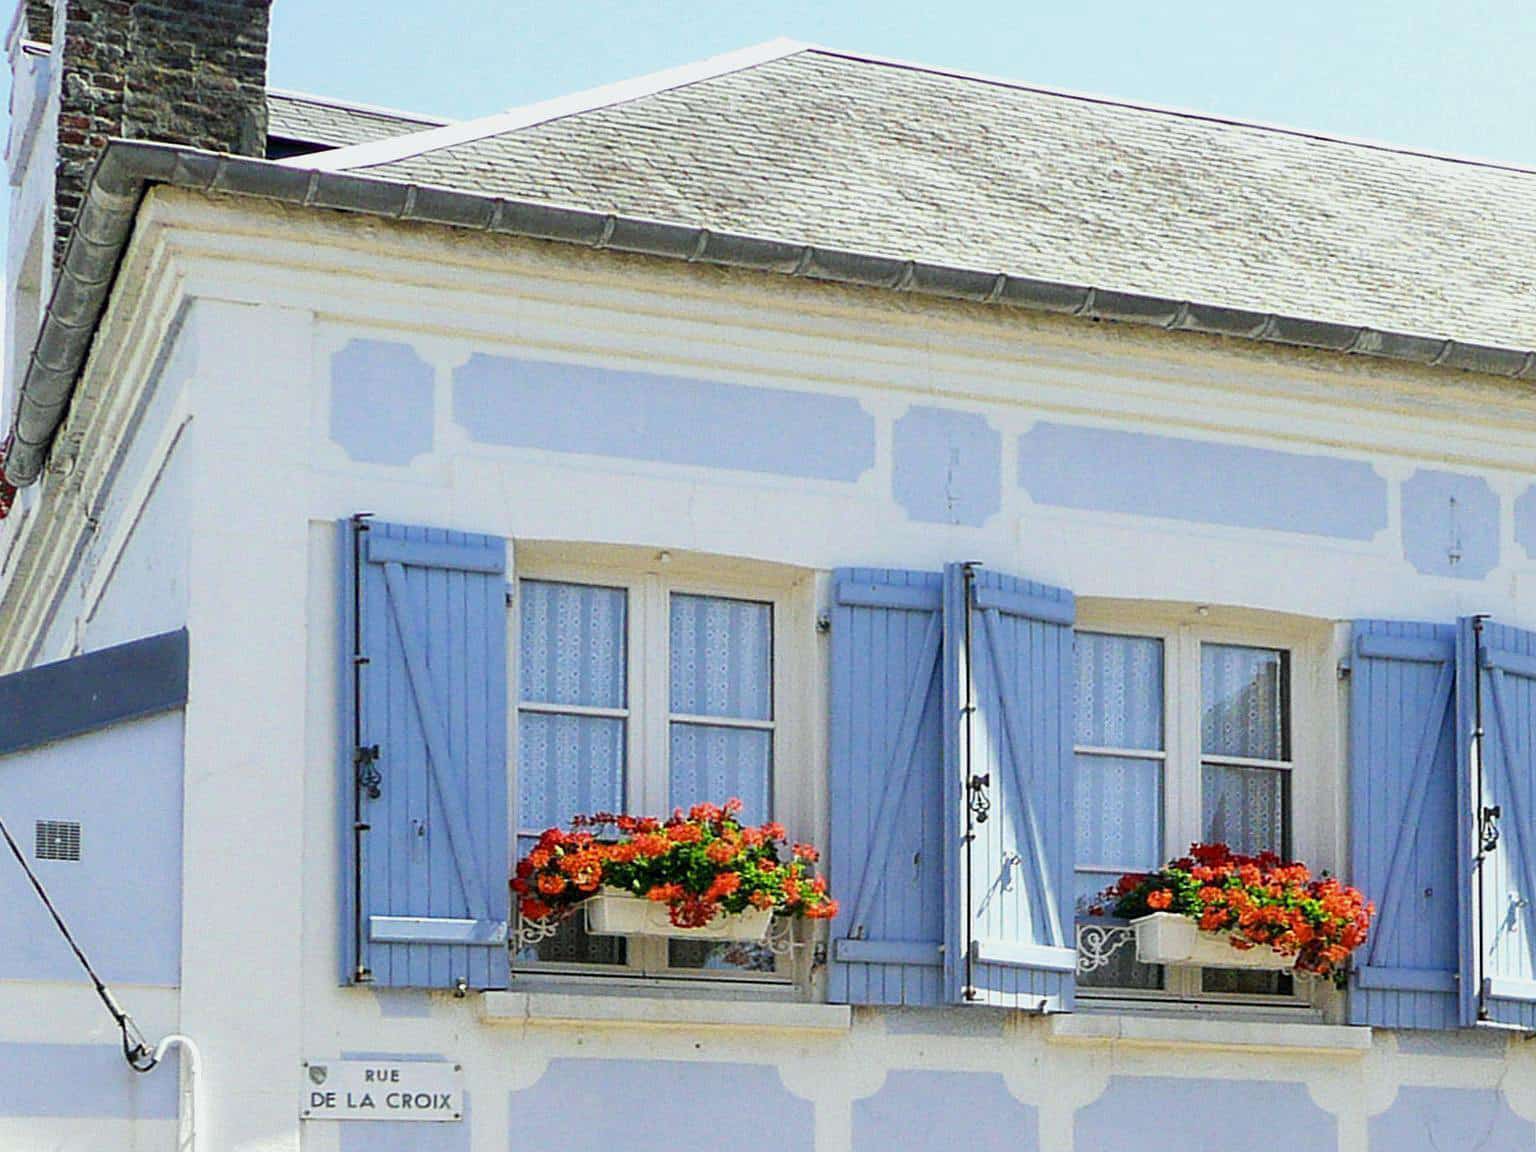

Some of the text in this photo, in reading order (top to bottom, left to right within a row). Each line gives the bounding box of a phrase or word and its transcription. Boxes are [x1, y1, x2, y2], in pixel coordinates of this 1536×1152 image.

[365, 1069, 400, 1082] RUE
[311, 1092, 452, 1110] DE LA CROIX
